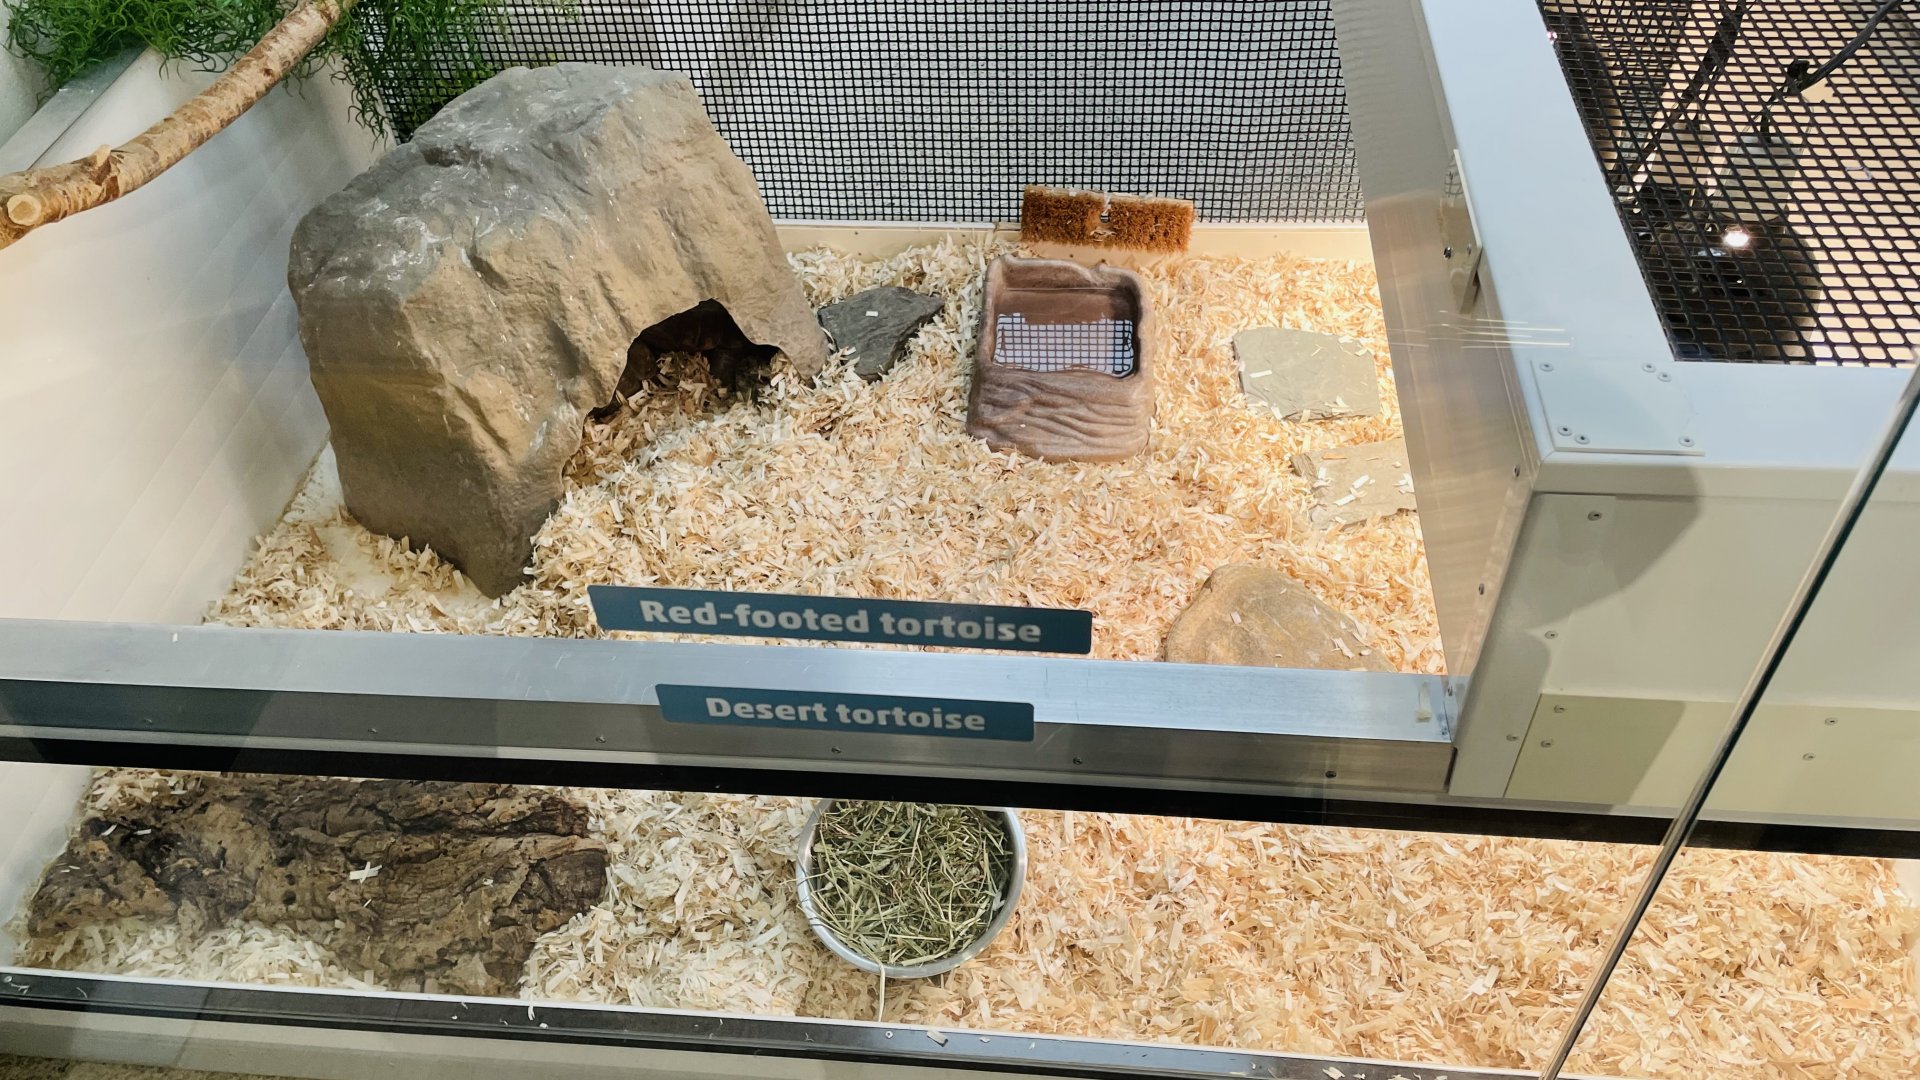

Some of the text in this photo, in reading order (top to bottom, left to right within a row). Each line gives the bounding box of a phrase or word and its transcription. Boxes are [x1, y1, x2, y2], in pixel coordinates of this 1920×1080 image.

[639, 600, 1042, 643] Red-footed tortoise
[706, 697, 986, 731] Desert tortoise
